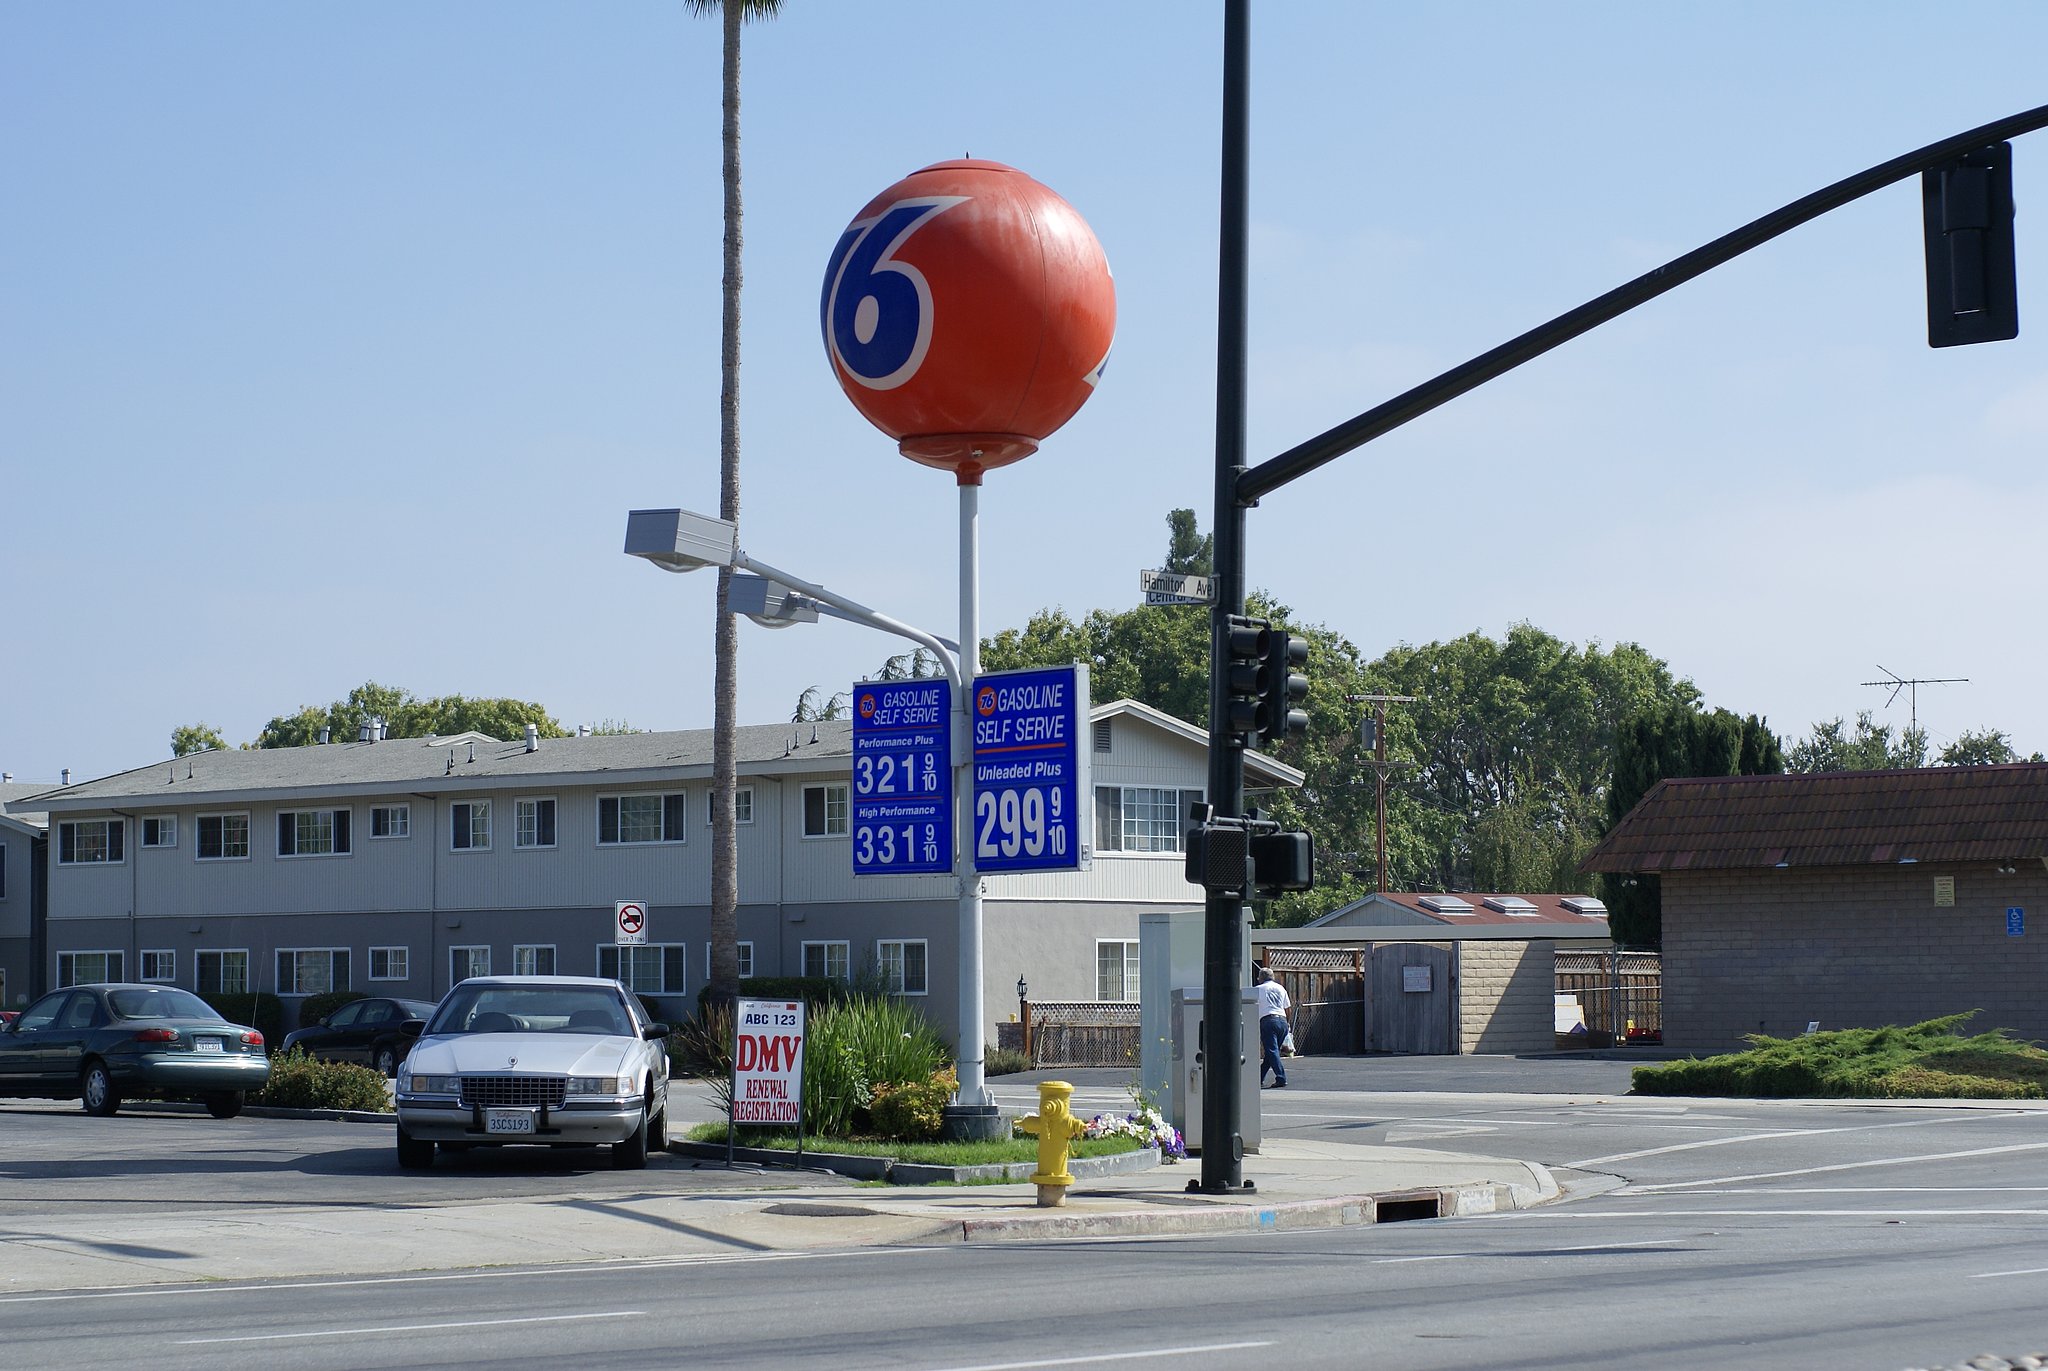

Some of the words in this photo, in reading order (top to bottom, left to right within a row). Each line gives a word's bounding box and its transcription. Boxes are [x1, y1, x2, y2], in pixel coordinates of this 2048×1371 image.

[1144, 573, 1186, 593] Hamilton
[1196, 580, 1212, 597] Ave
[861, 698, 874, 714] 76
[883, 689, 940, 708] GASOLINE
[979, 691, 995, 710] 76
[997, 684, 1064, 712] GASOLINE
[873, 709, 900, 725] SELF
[903, 707, 939, 724] SERVE
[976, 719, 1011, 744] SELF
[1015, 715, 1065, 742] SERVE
[859, 737, 912, 748] Performance
[914, 735, 934, 745] Plus
[856, 754, 914, 794] 321
[978, 762, 1032, 781] Unleaded
[1034, 761, 1062, 777] Plus
[859, 807, 878, 819] High
[880, 806, 935, 817] Performance
[977, 787, 1045, 858] 299
[856, 825, 915, 864] 331
[745, 1013, 769, 1025] ABC
[774, 1014, 796, 1026] 123
[736, 1034, 802, 1072] DMV
[746, 1079, 788, 1100] RENEWAL
[733, 1100, 799, 1121] REGISTRATION
[490, 1119, 529, 1130] 3SCS193
